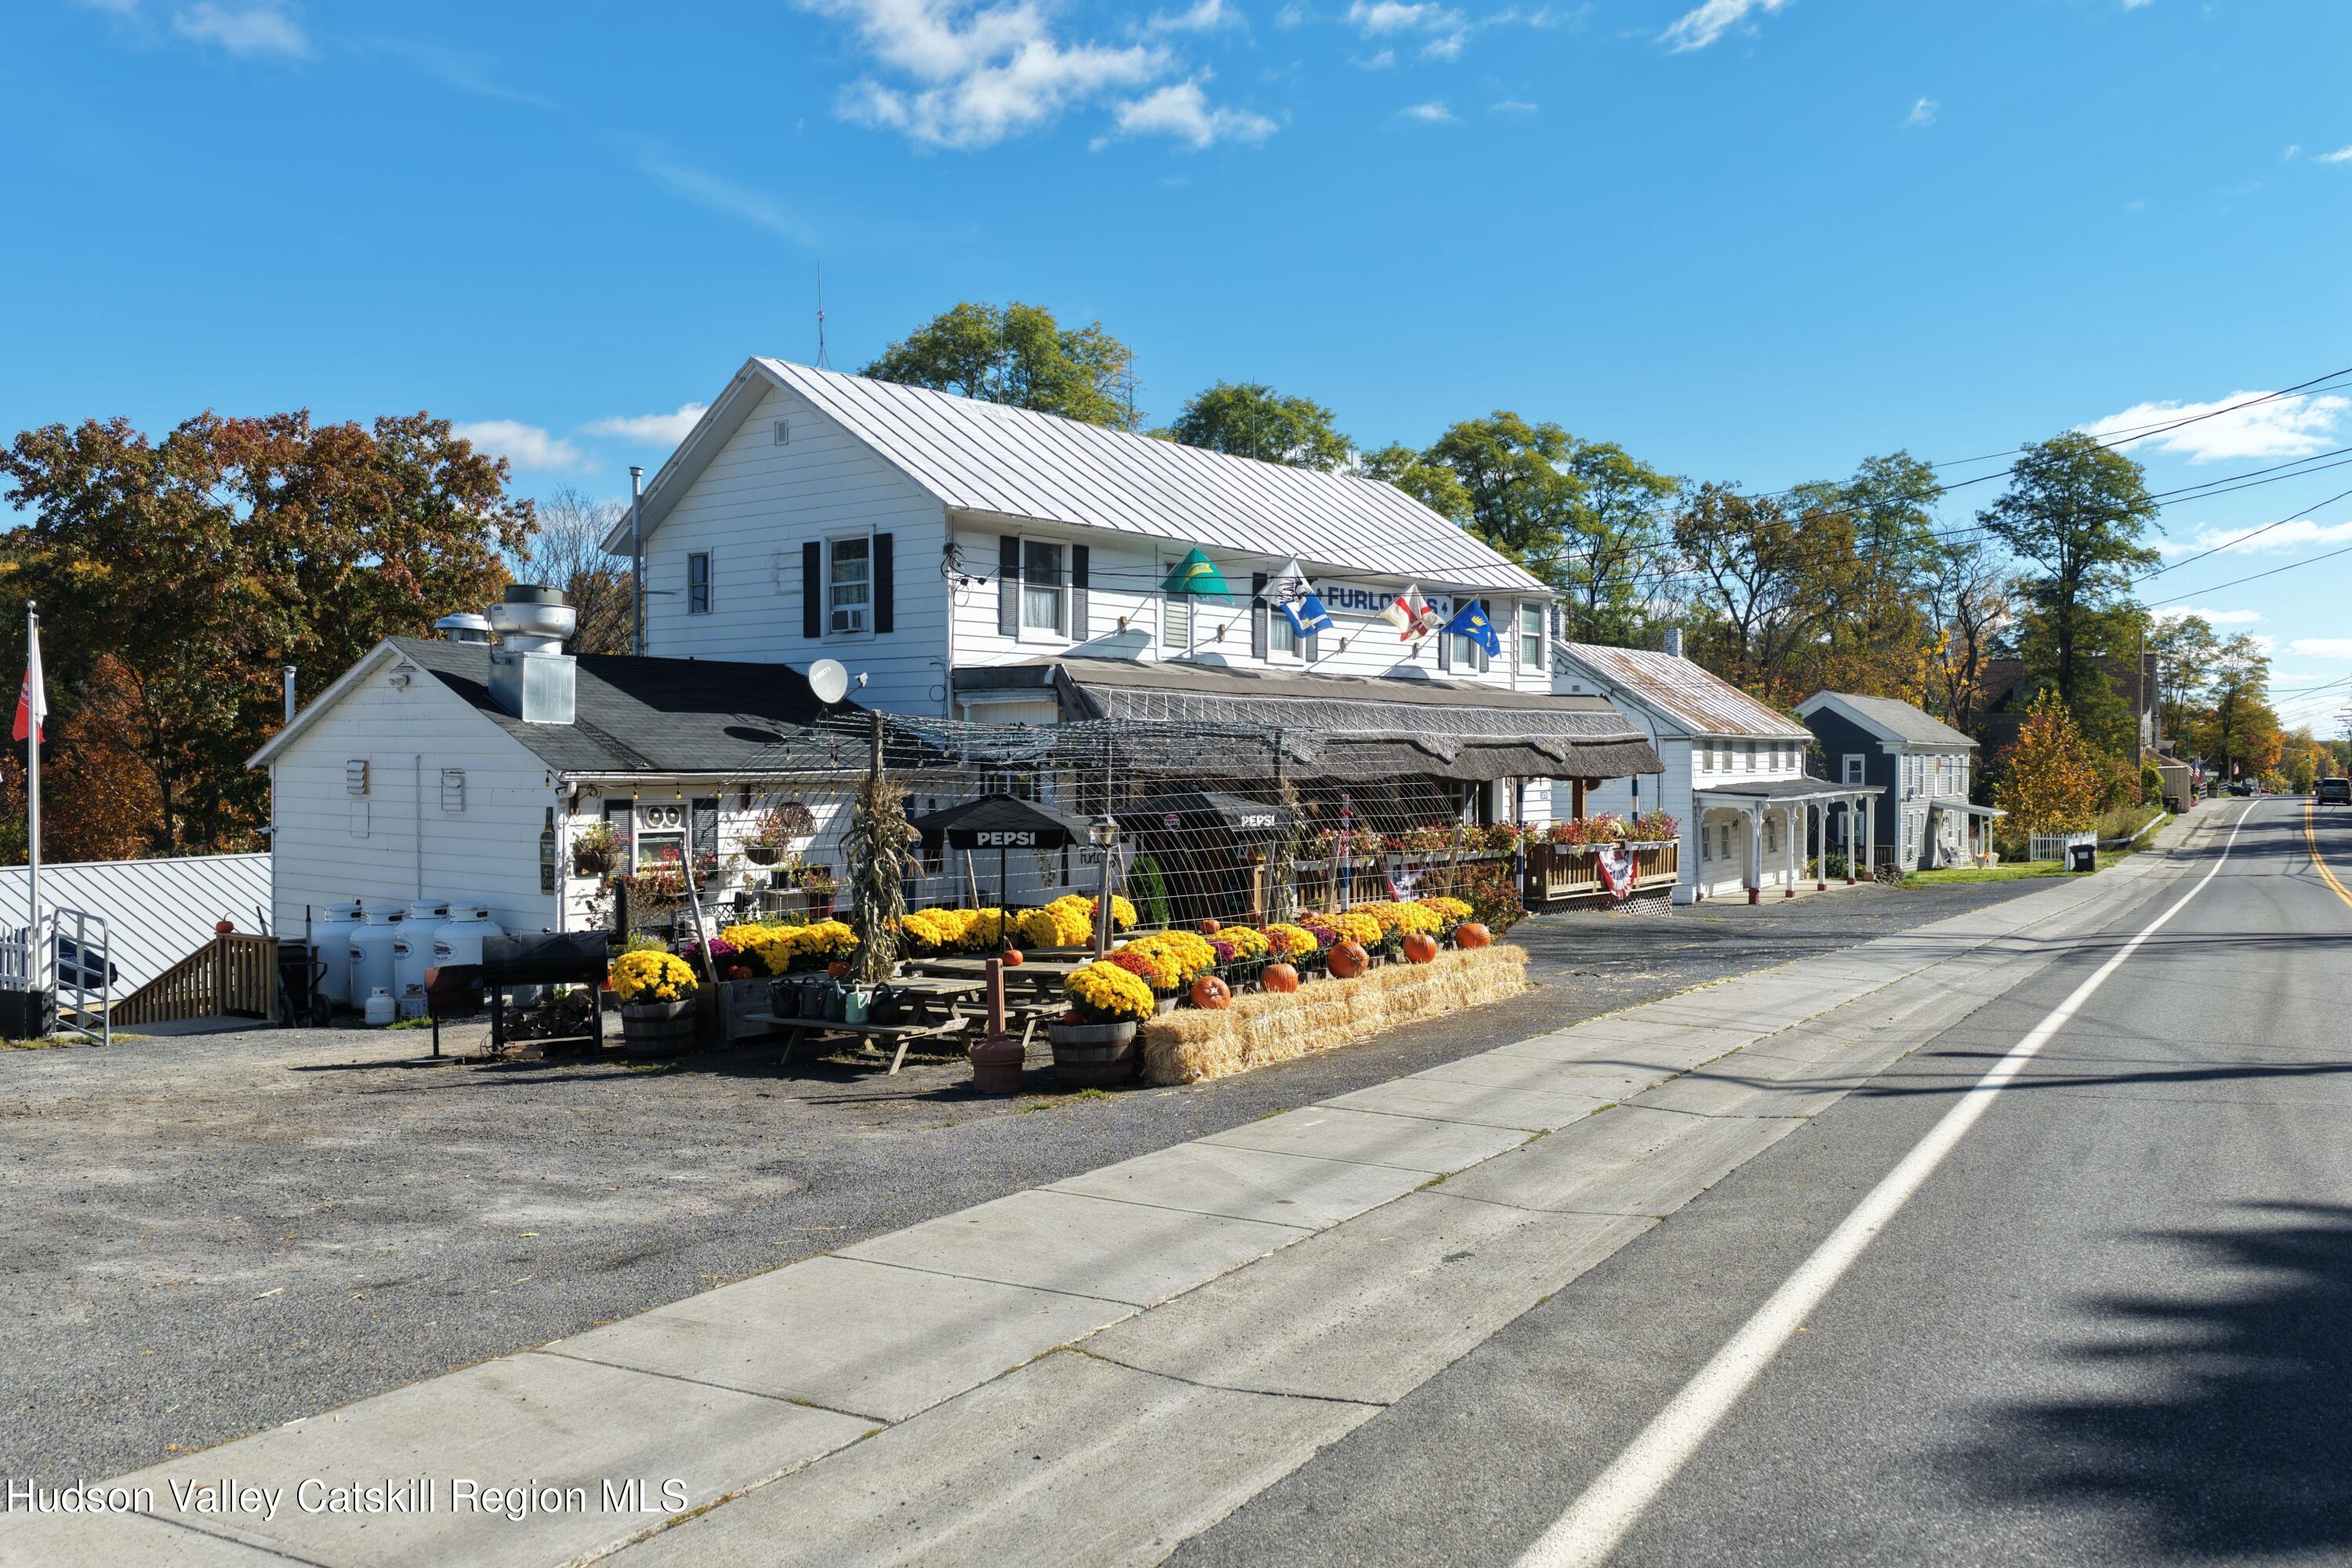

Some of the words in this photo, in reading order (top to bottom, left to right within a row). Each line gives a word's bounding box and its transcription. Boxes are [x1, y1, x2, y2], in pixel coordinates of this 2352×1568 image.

[1327, 586, 1438, 615] FURLOS
[1241, 815, 1276, 827] PEPSI
[977, 831, 1036, 846] PEPSI
